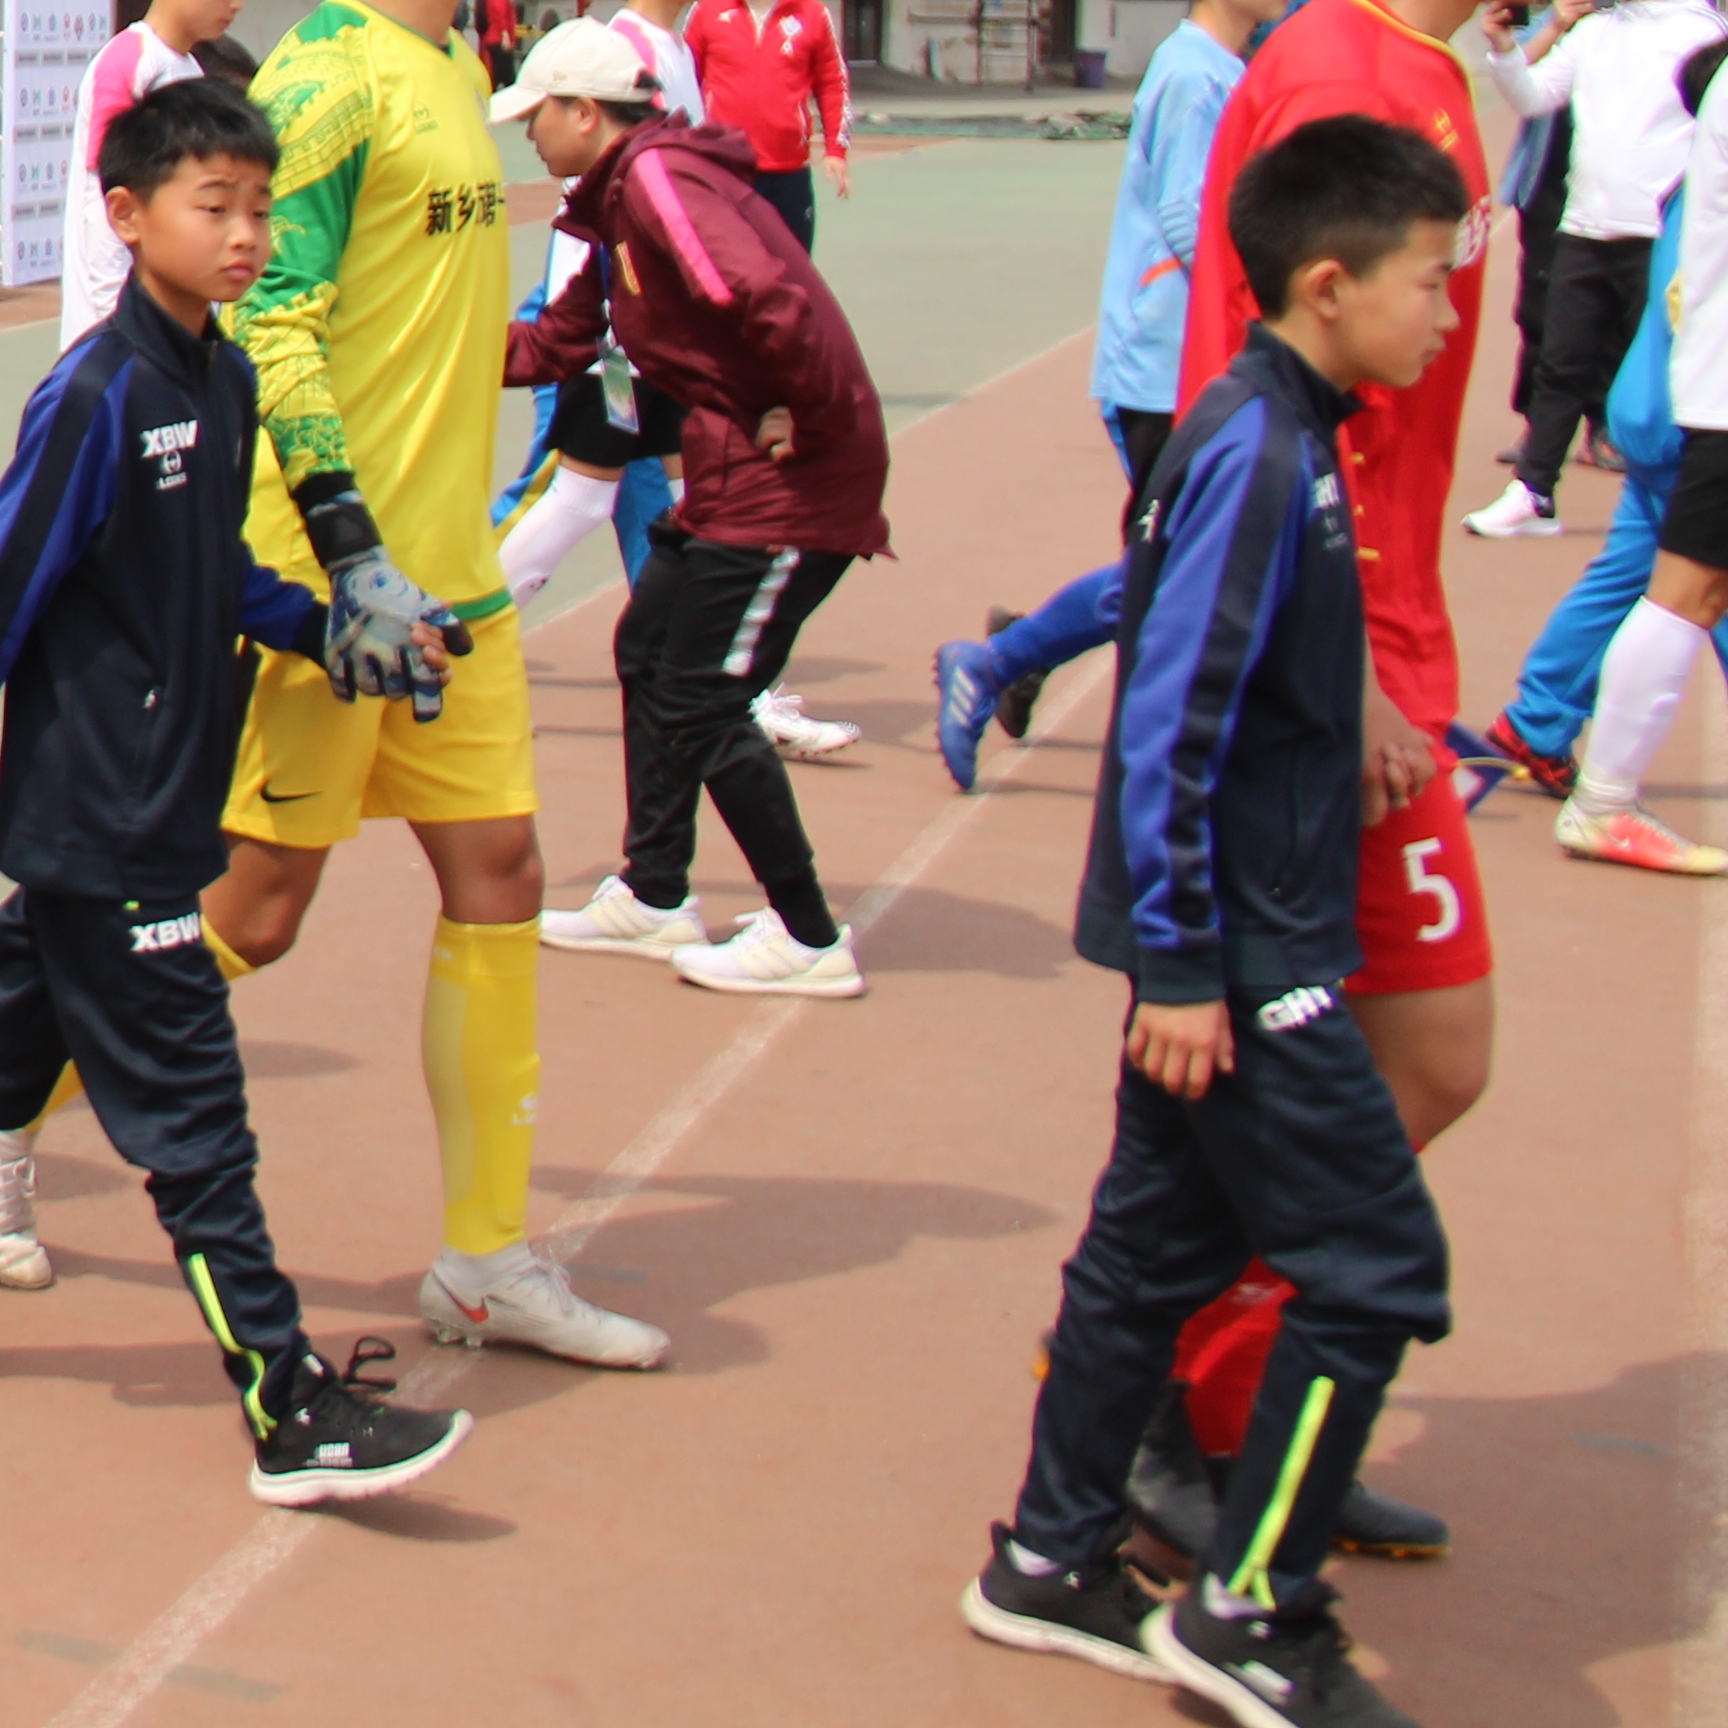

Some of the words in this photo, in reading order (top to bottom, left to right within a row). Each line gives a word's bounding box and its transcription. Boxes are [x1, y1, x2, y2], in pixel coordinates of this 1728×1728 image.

[142, 419, 198, 459] XBW
[1404, 835, 1462, 944] 5
[129, 910, 202, 954] XBW
